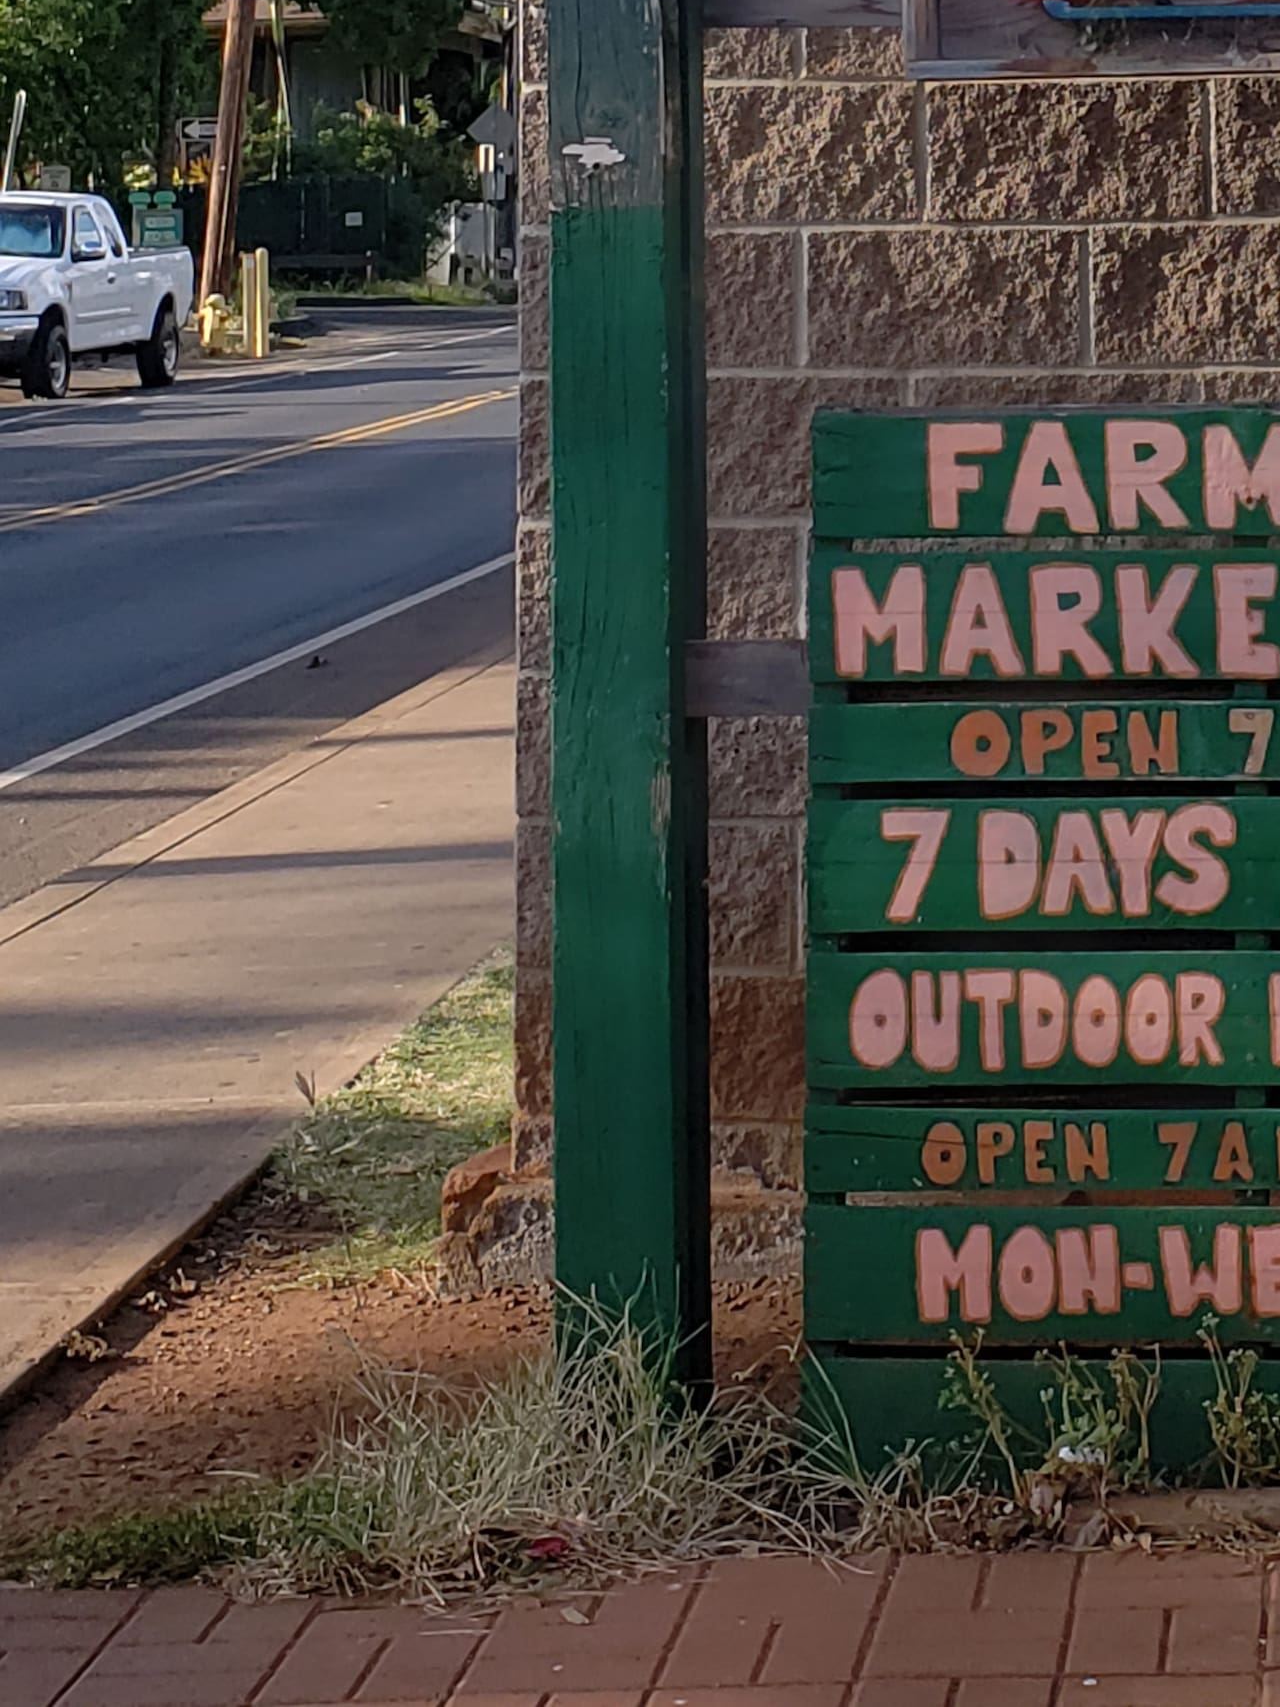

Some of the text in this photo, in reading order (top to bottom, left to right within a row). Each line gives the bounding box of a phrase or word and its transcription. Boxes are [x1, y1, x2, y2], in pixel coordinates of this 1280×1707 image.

[950, 709, 1180, 777] OPEN
[880, 808, 951, 923] 7
[977, 800, 1238, 918] DAYS
[848, 967, 1227, 1074] OUTDOOR
[921, 1122, 1110, 1186] OPEN
